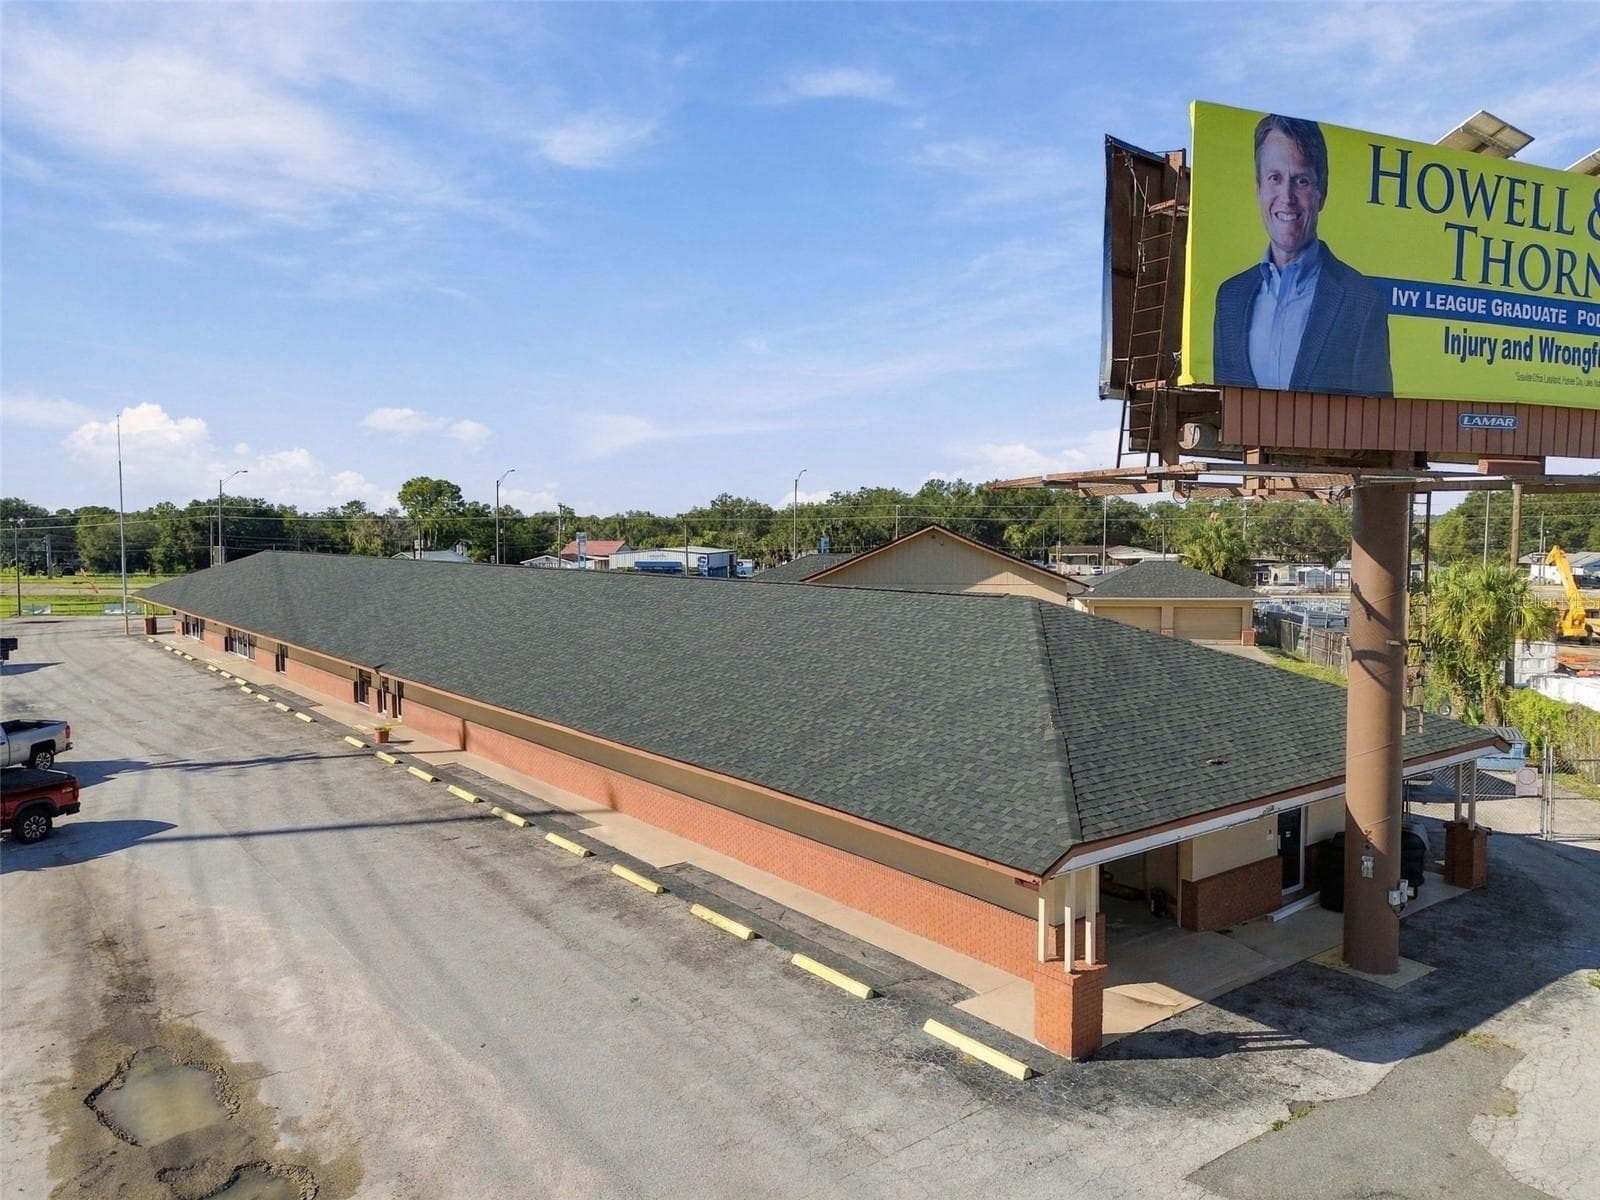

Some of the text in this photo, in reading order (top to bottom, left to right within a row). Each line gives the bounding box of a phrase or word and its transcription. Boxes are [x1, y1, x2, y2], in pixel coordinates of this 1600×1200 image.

[1366, 143, 1576, 236] HOWELL
[1392, 287, 1421, 308] IVY
[1425, 290, 1487, 315] LEAGUE
[1491, 298, 1568, 325] GRADUATE
[1444, 326, 1600, 374] Injury and Wrongf
[1463, 416, 1514, 427] LAMAR
